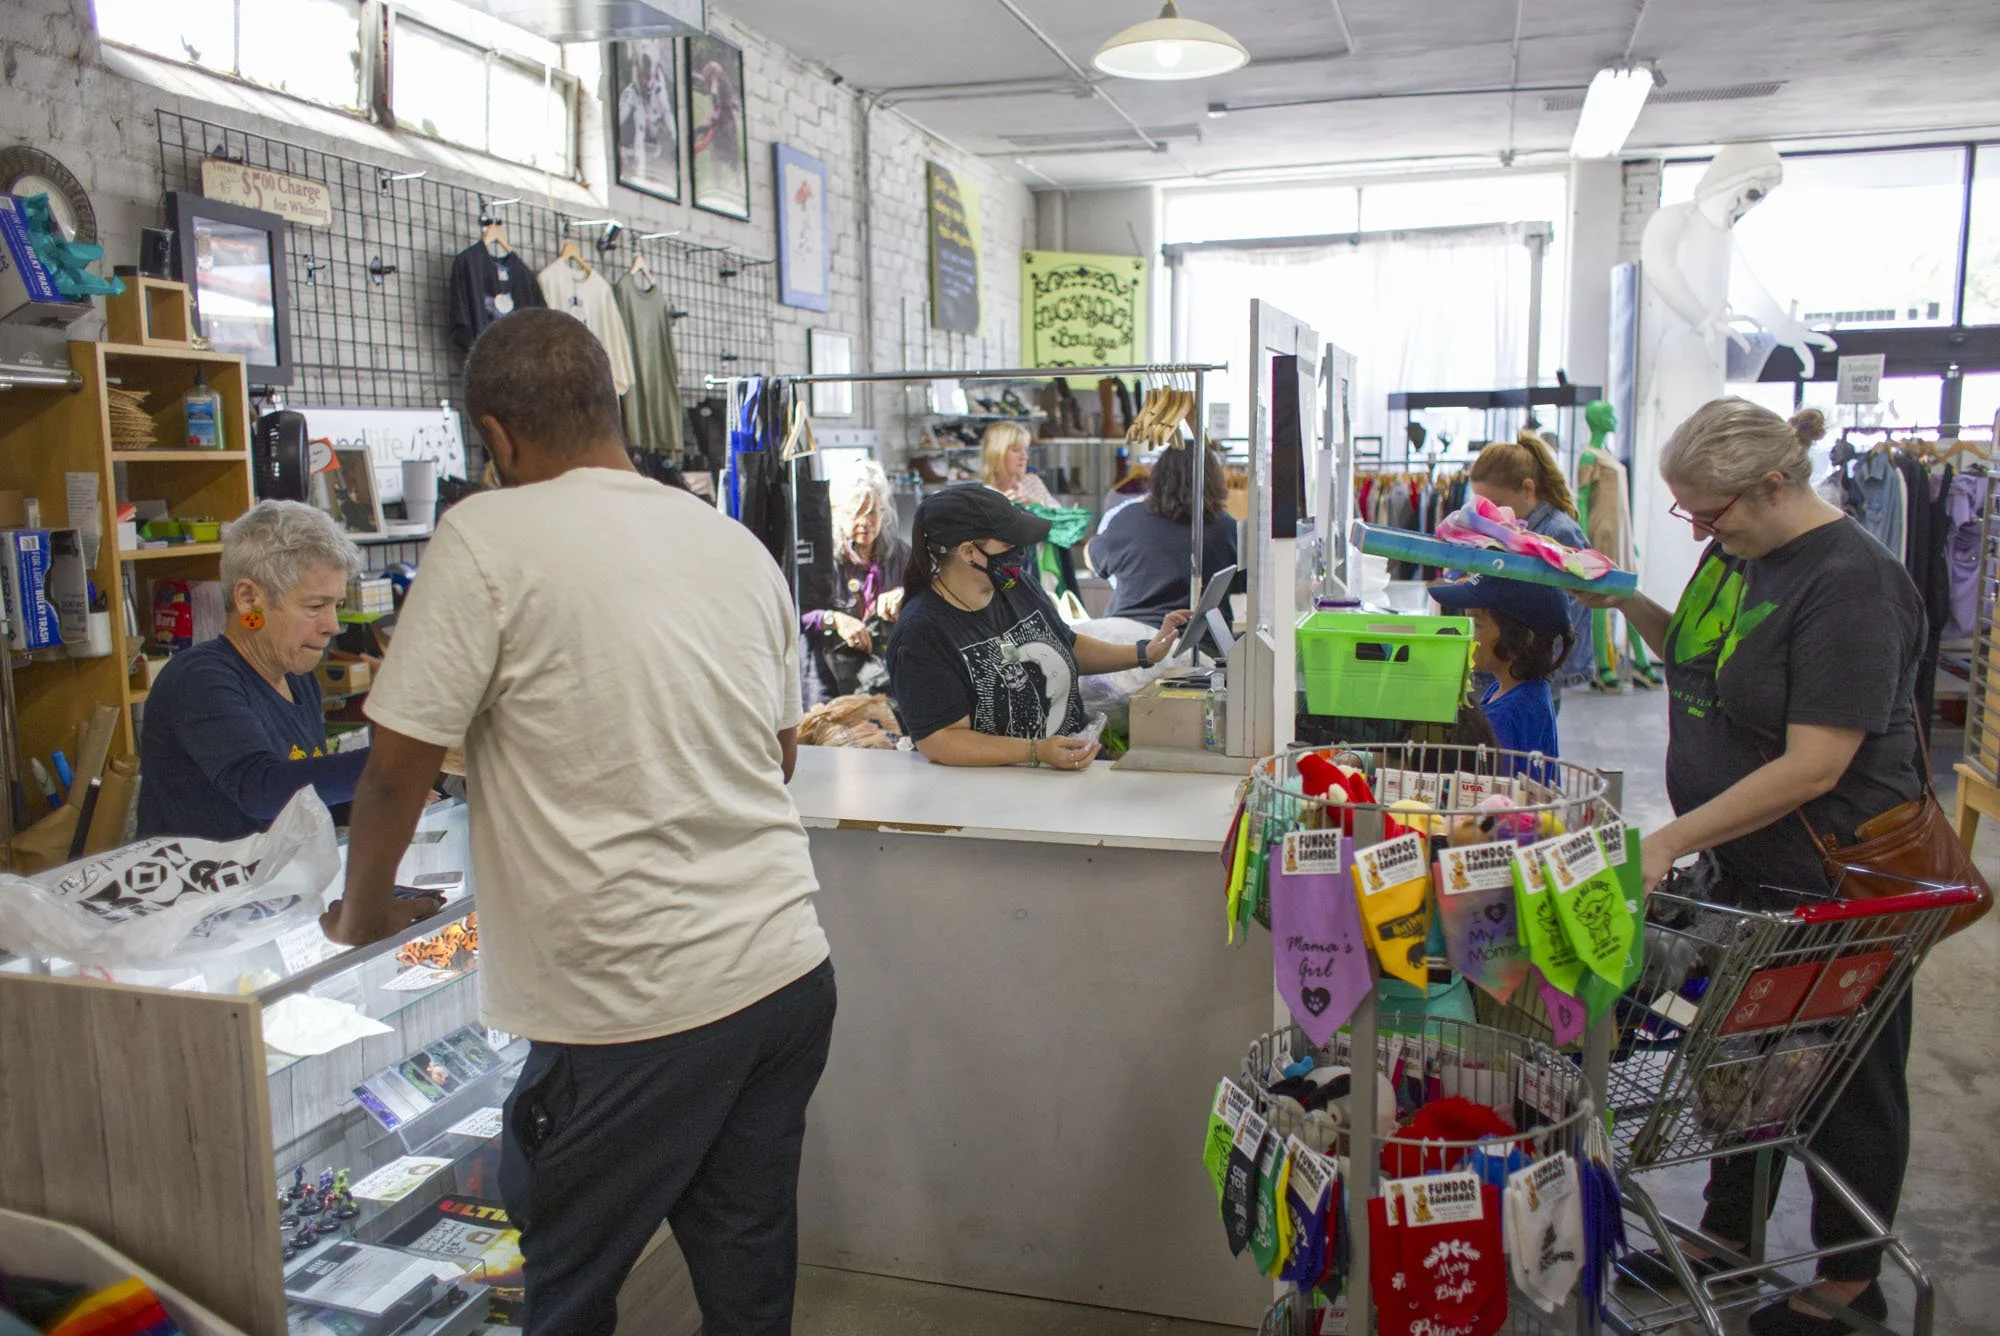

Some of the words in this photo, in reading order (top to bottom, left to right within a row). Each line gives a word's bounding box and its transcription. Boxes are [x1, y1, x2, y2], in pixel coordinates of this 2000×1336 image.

[277, 176, 322, 205] Charge
[273, 197, 288, 212] for
[24, 244, 43, 268] BULKY
[34, 266, 54, 297] TRASH
[31, 551, 42, 567] FOR
[34, 567, 44, 589] LIGHT
[35, 588, 47, 613] BULKY
[38, 615, 50, 644] TRASH
[1461, 782, 1484, 793] USA
[1299, 833, 1337, 848] FUNDOG
[1376, 838, 1417, 860] FUNDOG
[1560, 831, 1593, 854] FUNDOG
[1299, 849, 1337, 861] BANDANAS
[1379, 851, 1418, 871] BANDANAS
[1465, 845, 1513, 861] FUNDOG
[1472, 911, 1481, 924] I
[1286, 931, 1354, 954] Mama's
[1298, 957, 1335, 987] Girl
[1299, 1149, 1325, 1182] FUNDOG
[1533, 1155, 1564, 1181] FUNDOG
[1428, 1180, 1475, 1195] FUNDOG
[1429, 1192, 1476, 1206] BANDANAS
[1434, 1278, 1477, 1304] Bright
